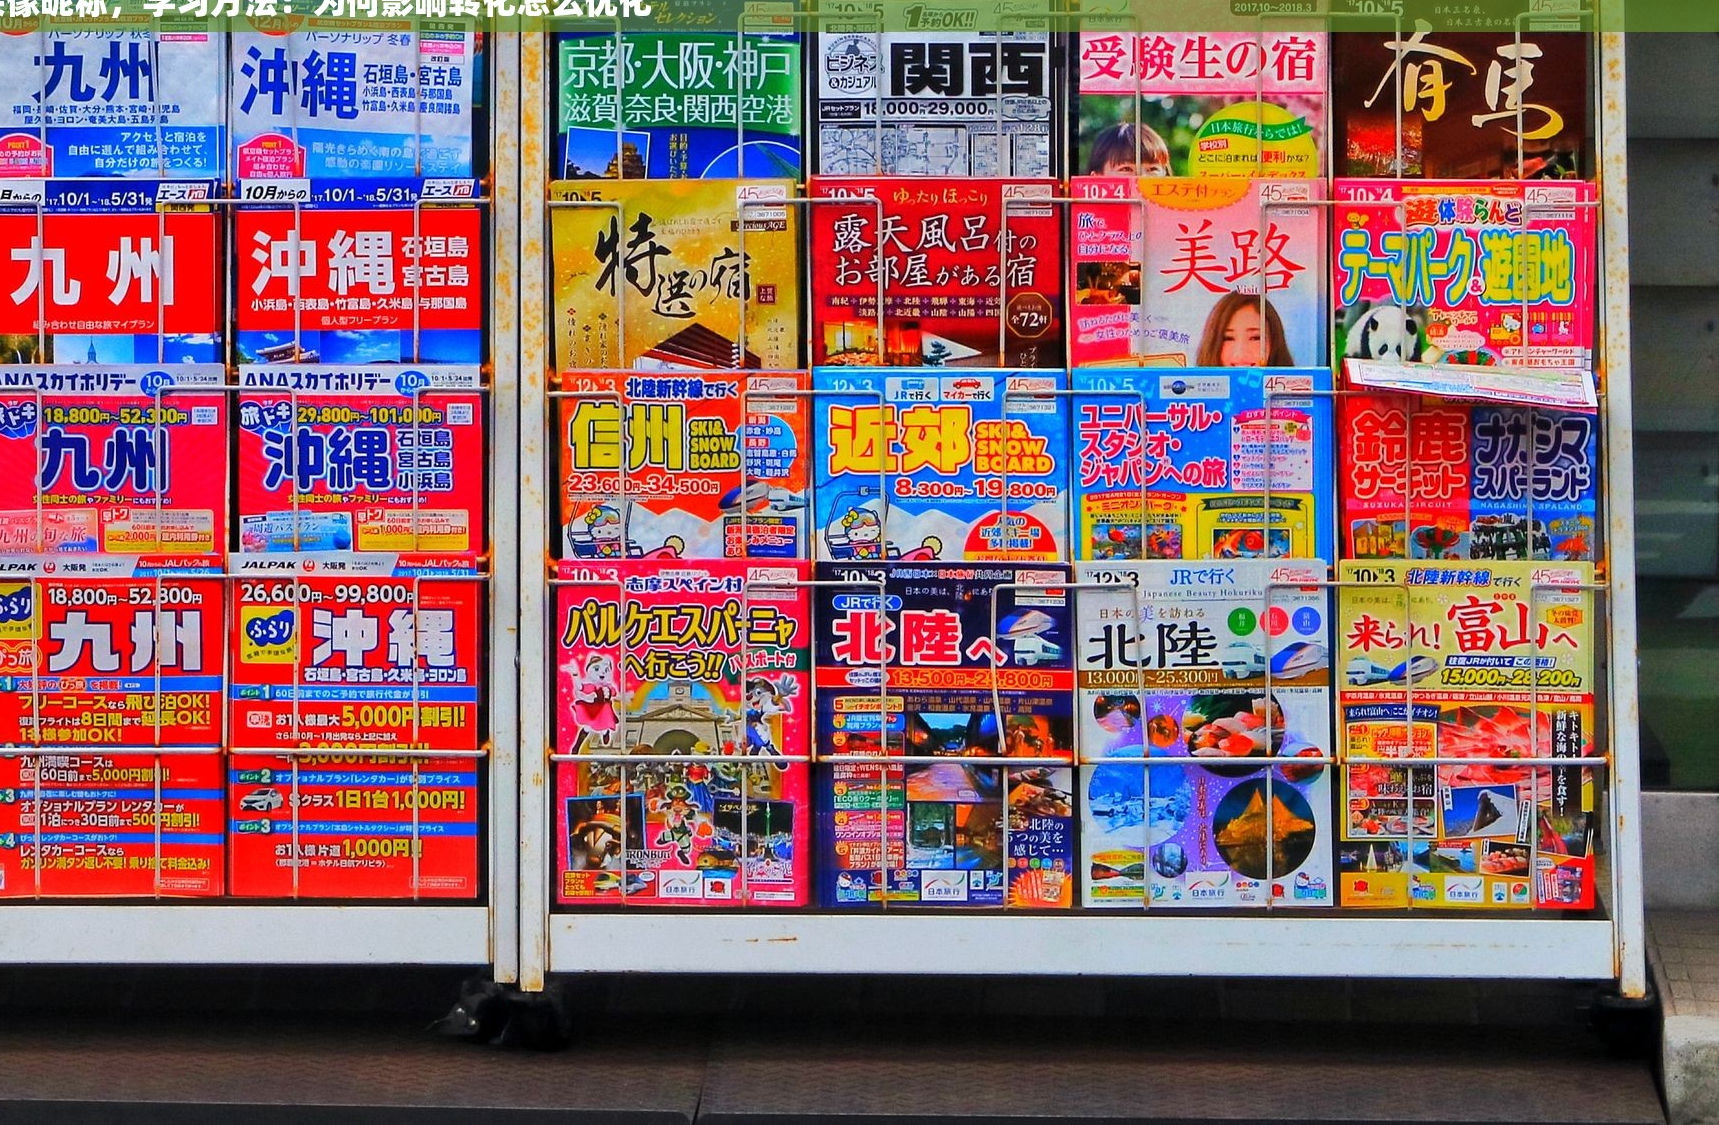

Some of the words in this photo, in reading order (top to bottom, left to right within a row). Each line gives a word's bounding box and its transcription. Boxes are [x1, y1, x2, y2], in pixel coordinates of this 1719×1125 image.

[31, 40, 160, 105] 九州
[563, 39, 792, 90] 京都・大阪・神戸
[890, 42, 1046, 98] 関西
[1082, 35, 1318, 82] 受験生の宿
[1364, 17, 1565, 141] 有馬
[401, 235, 470, 260] 石垣島
[832, 214, 1037, 254] 露天風呂付の
[1160, 218, 1307, 294] 美路
[10, 235, 174, 308] 九州
[401, 265, 470, 289] 宮古島
[595, 213, 751, 320] 特選の宿
[834, 253, 1037, 289] お部屋がある宿
[1236, 285, 1260, 295] Visit
[321, 315, 398, 325] 個人型フリープラン
[625, 378, 737, 400] 北陸新幹線で行く
[570, 401, 684, 472] 信州
[829, 404, 971, 476] 近郊
[1352, 411, 1466, 464] 鈴鹿
[1473, 412, 1591, 465] ナガシマ
[1079, 458, 1227, 488] ジャパンへの旅
[1353, 467, 1466, 500] サーキット
[1473, 466, 1591, 500] スパーランド
[62, 561, 86, 572] 大阪発
[625, 576, 743, 594] 志摩スペイン村
[1169, 567, 1235, 586] JRで行く
[1143, 590, 1182, 598] Japanese
[1186, 590, 1216, 598] Beauty
[565, 603, 797, 648] パルケエスパーニャ
[832, 610, 1008, 666] 北陸へ
[1086, 621, 1223, 669] 北陸
[1447, 597, 1579, 653] 富山へ
